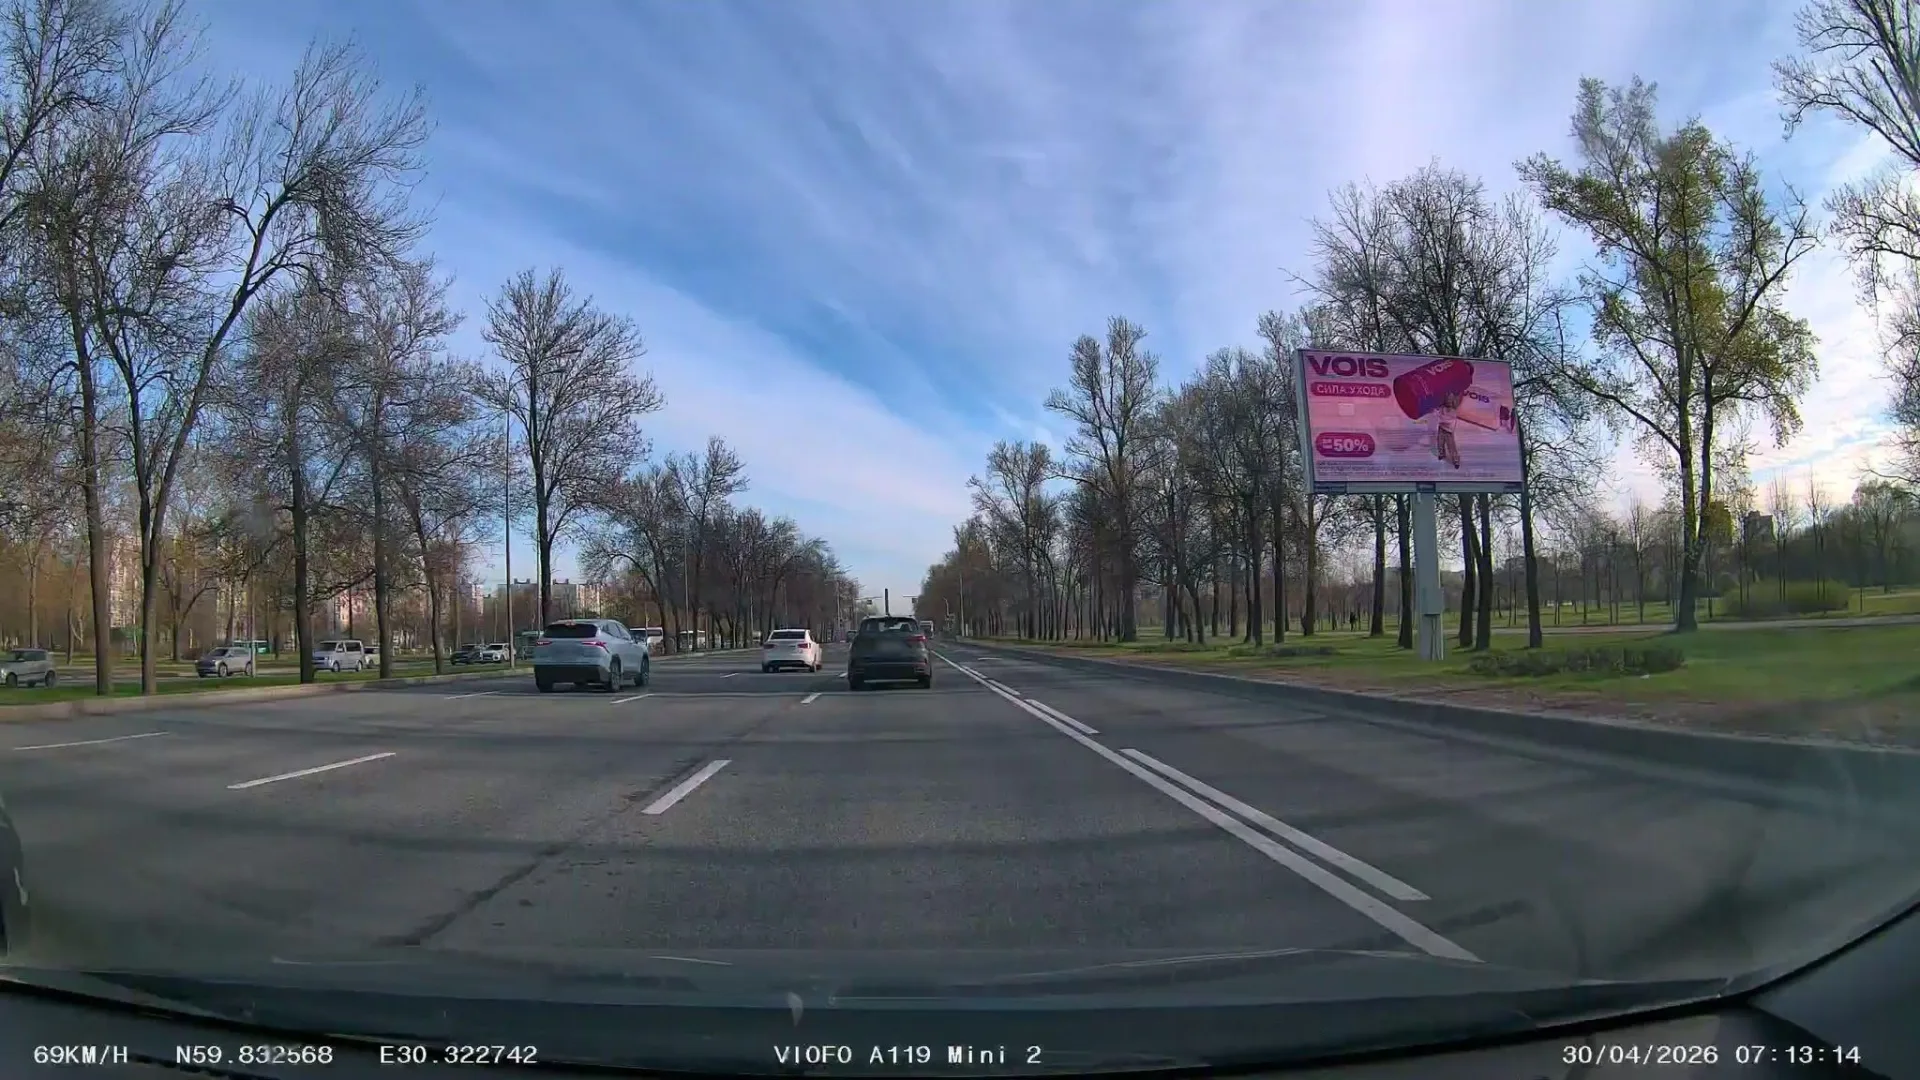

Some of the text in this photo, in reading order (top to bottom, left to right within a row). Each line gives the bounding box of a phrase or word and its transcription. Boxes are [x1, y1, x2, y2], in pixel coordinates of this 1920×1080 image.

[1306, 355, 1389, 378] VOIS
[1426, 358, 1455, 377] VOIS
[1349, 385, 1386, 396] УХОДА
